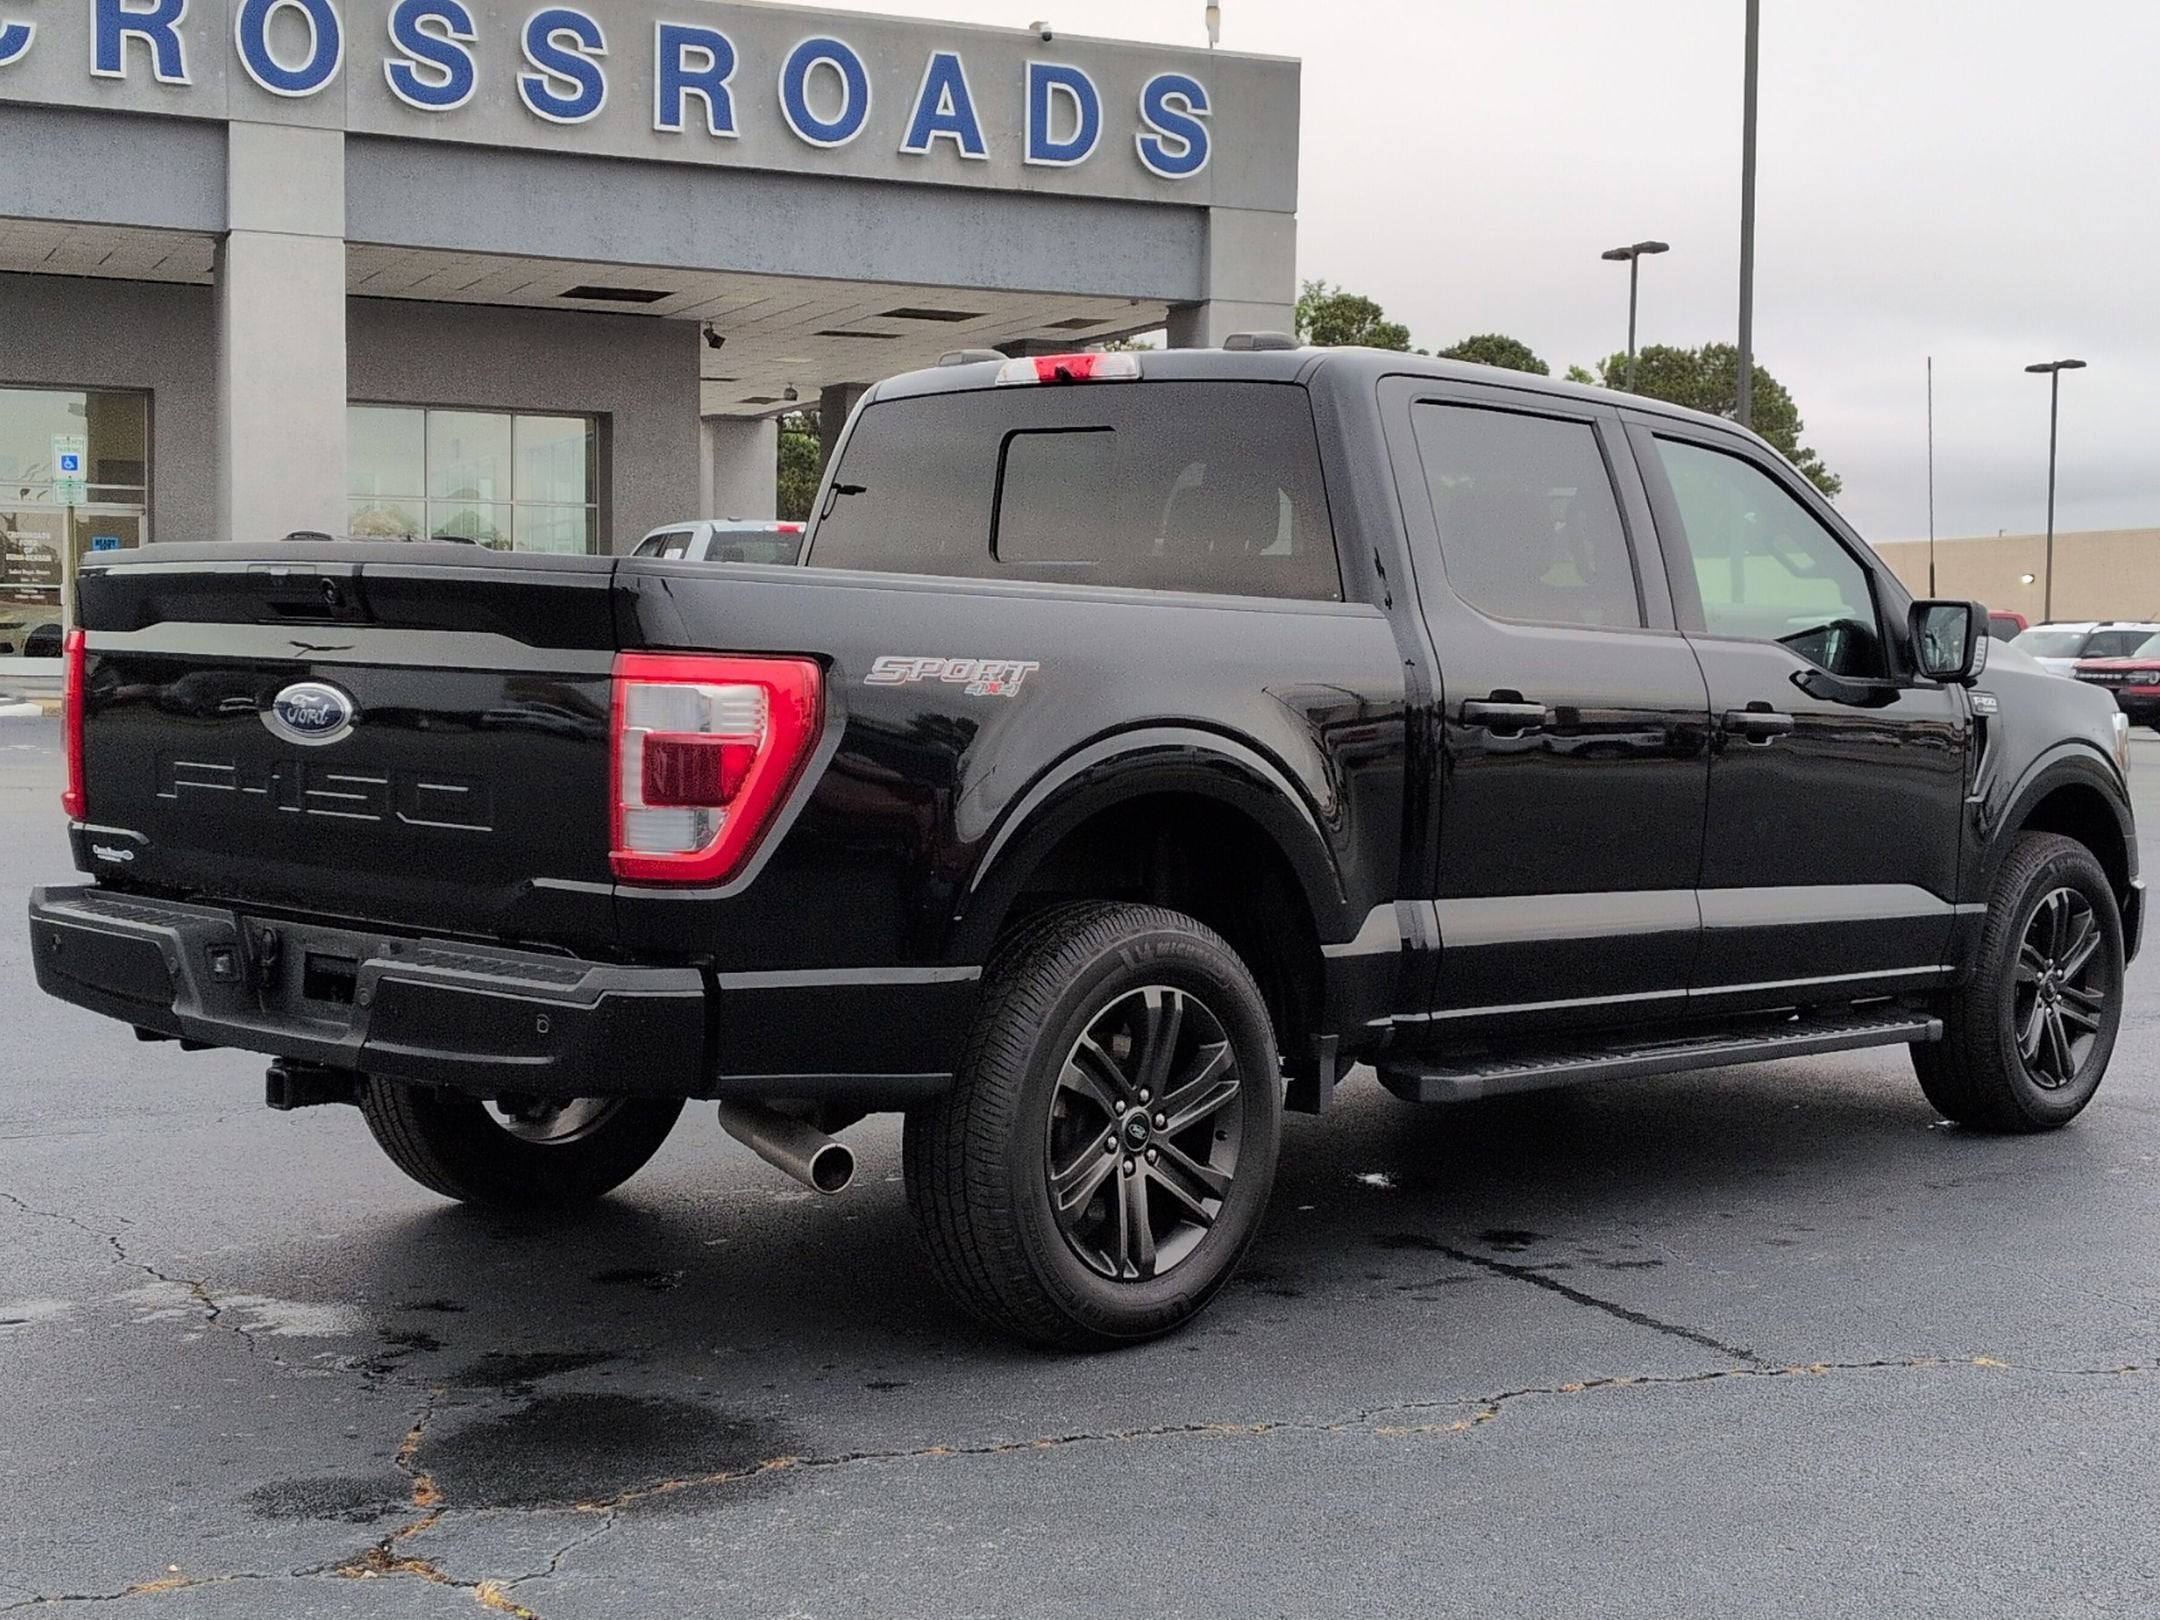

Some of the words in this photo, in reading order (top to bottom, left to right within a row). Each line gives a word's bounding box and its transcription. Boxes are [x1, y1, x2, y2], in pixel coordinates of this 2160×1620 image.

[0, 0, 1212, 180] ROSSROADS
[864, 656, 1040, 686] SPORT
[287, 694, 330, 725] Ford
